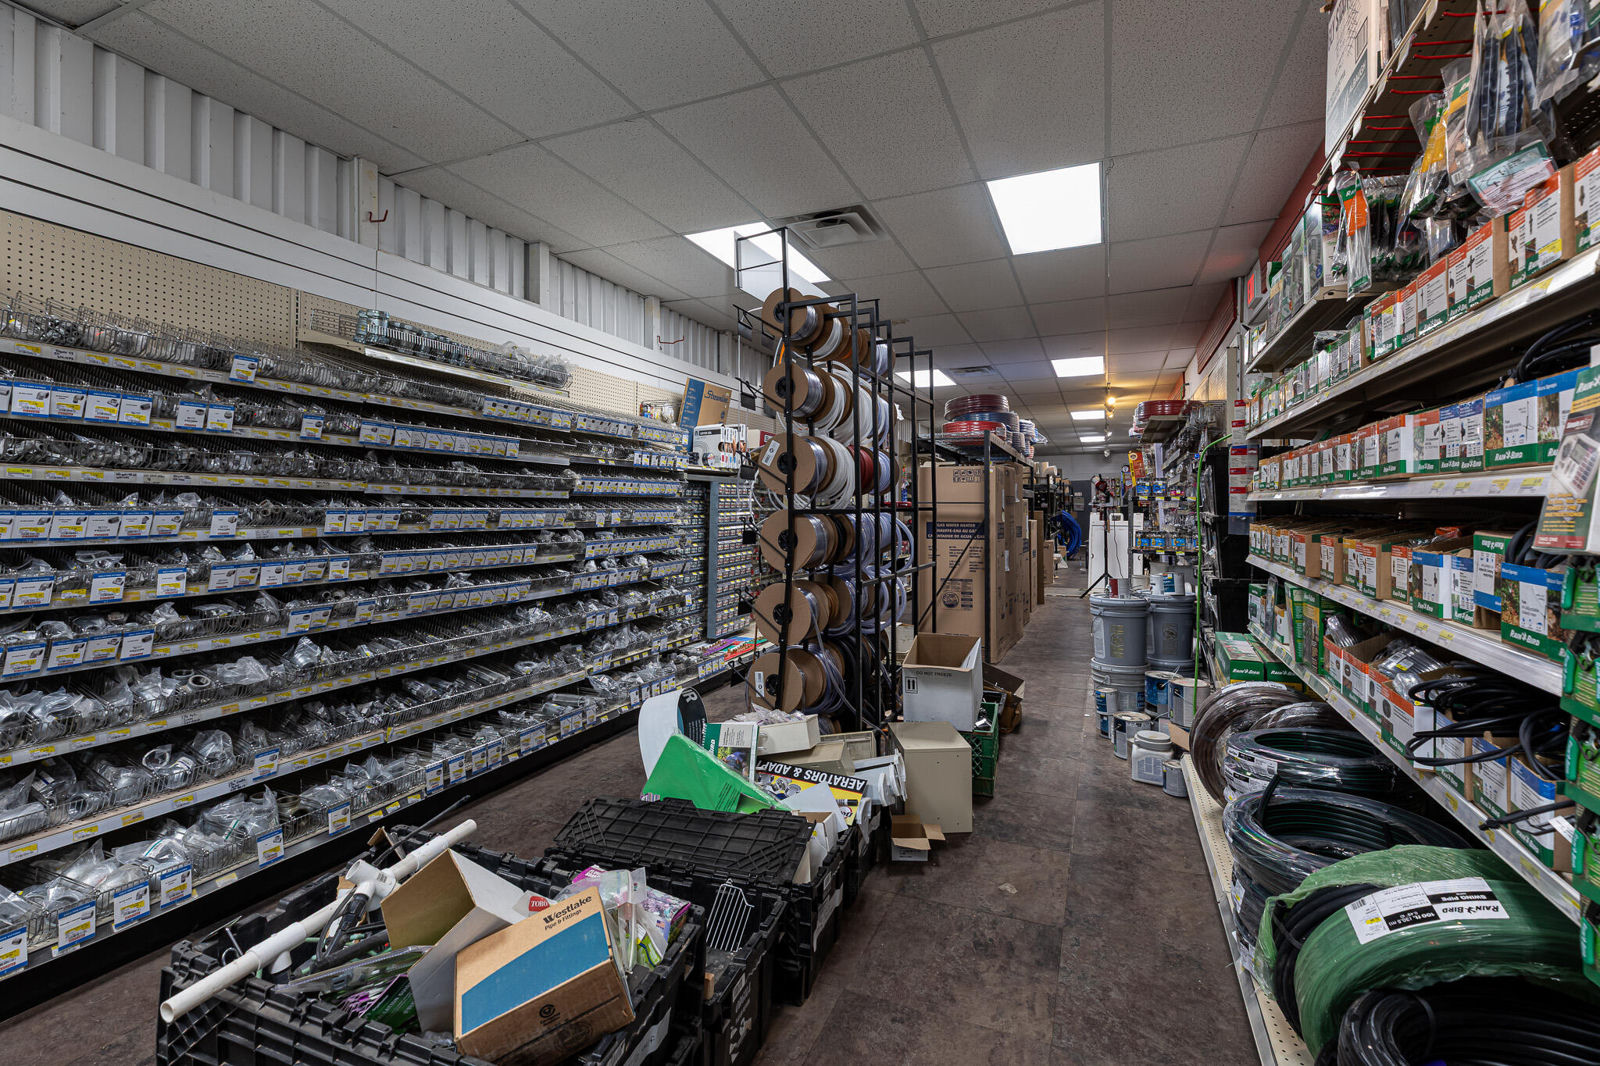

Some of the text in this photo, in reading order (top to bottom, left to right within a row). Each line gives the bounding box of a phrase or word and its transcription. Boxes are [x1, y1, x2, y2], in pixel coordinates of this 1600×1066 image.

[756, 760, 866, 791] AERATORS & ADAPT
[543, 896, 592, 924] Westlake
[1442, 905, 1499, 914] RAIN BIRD
